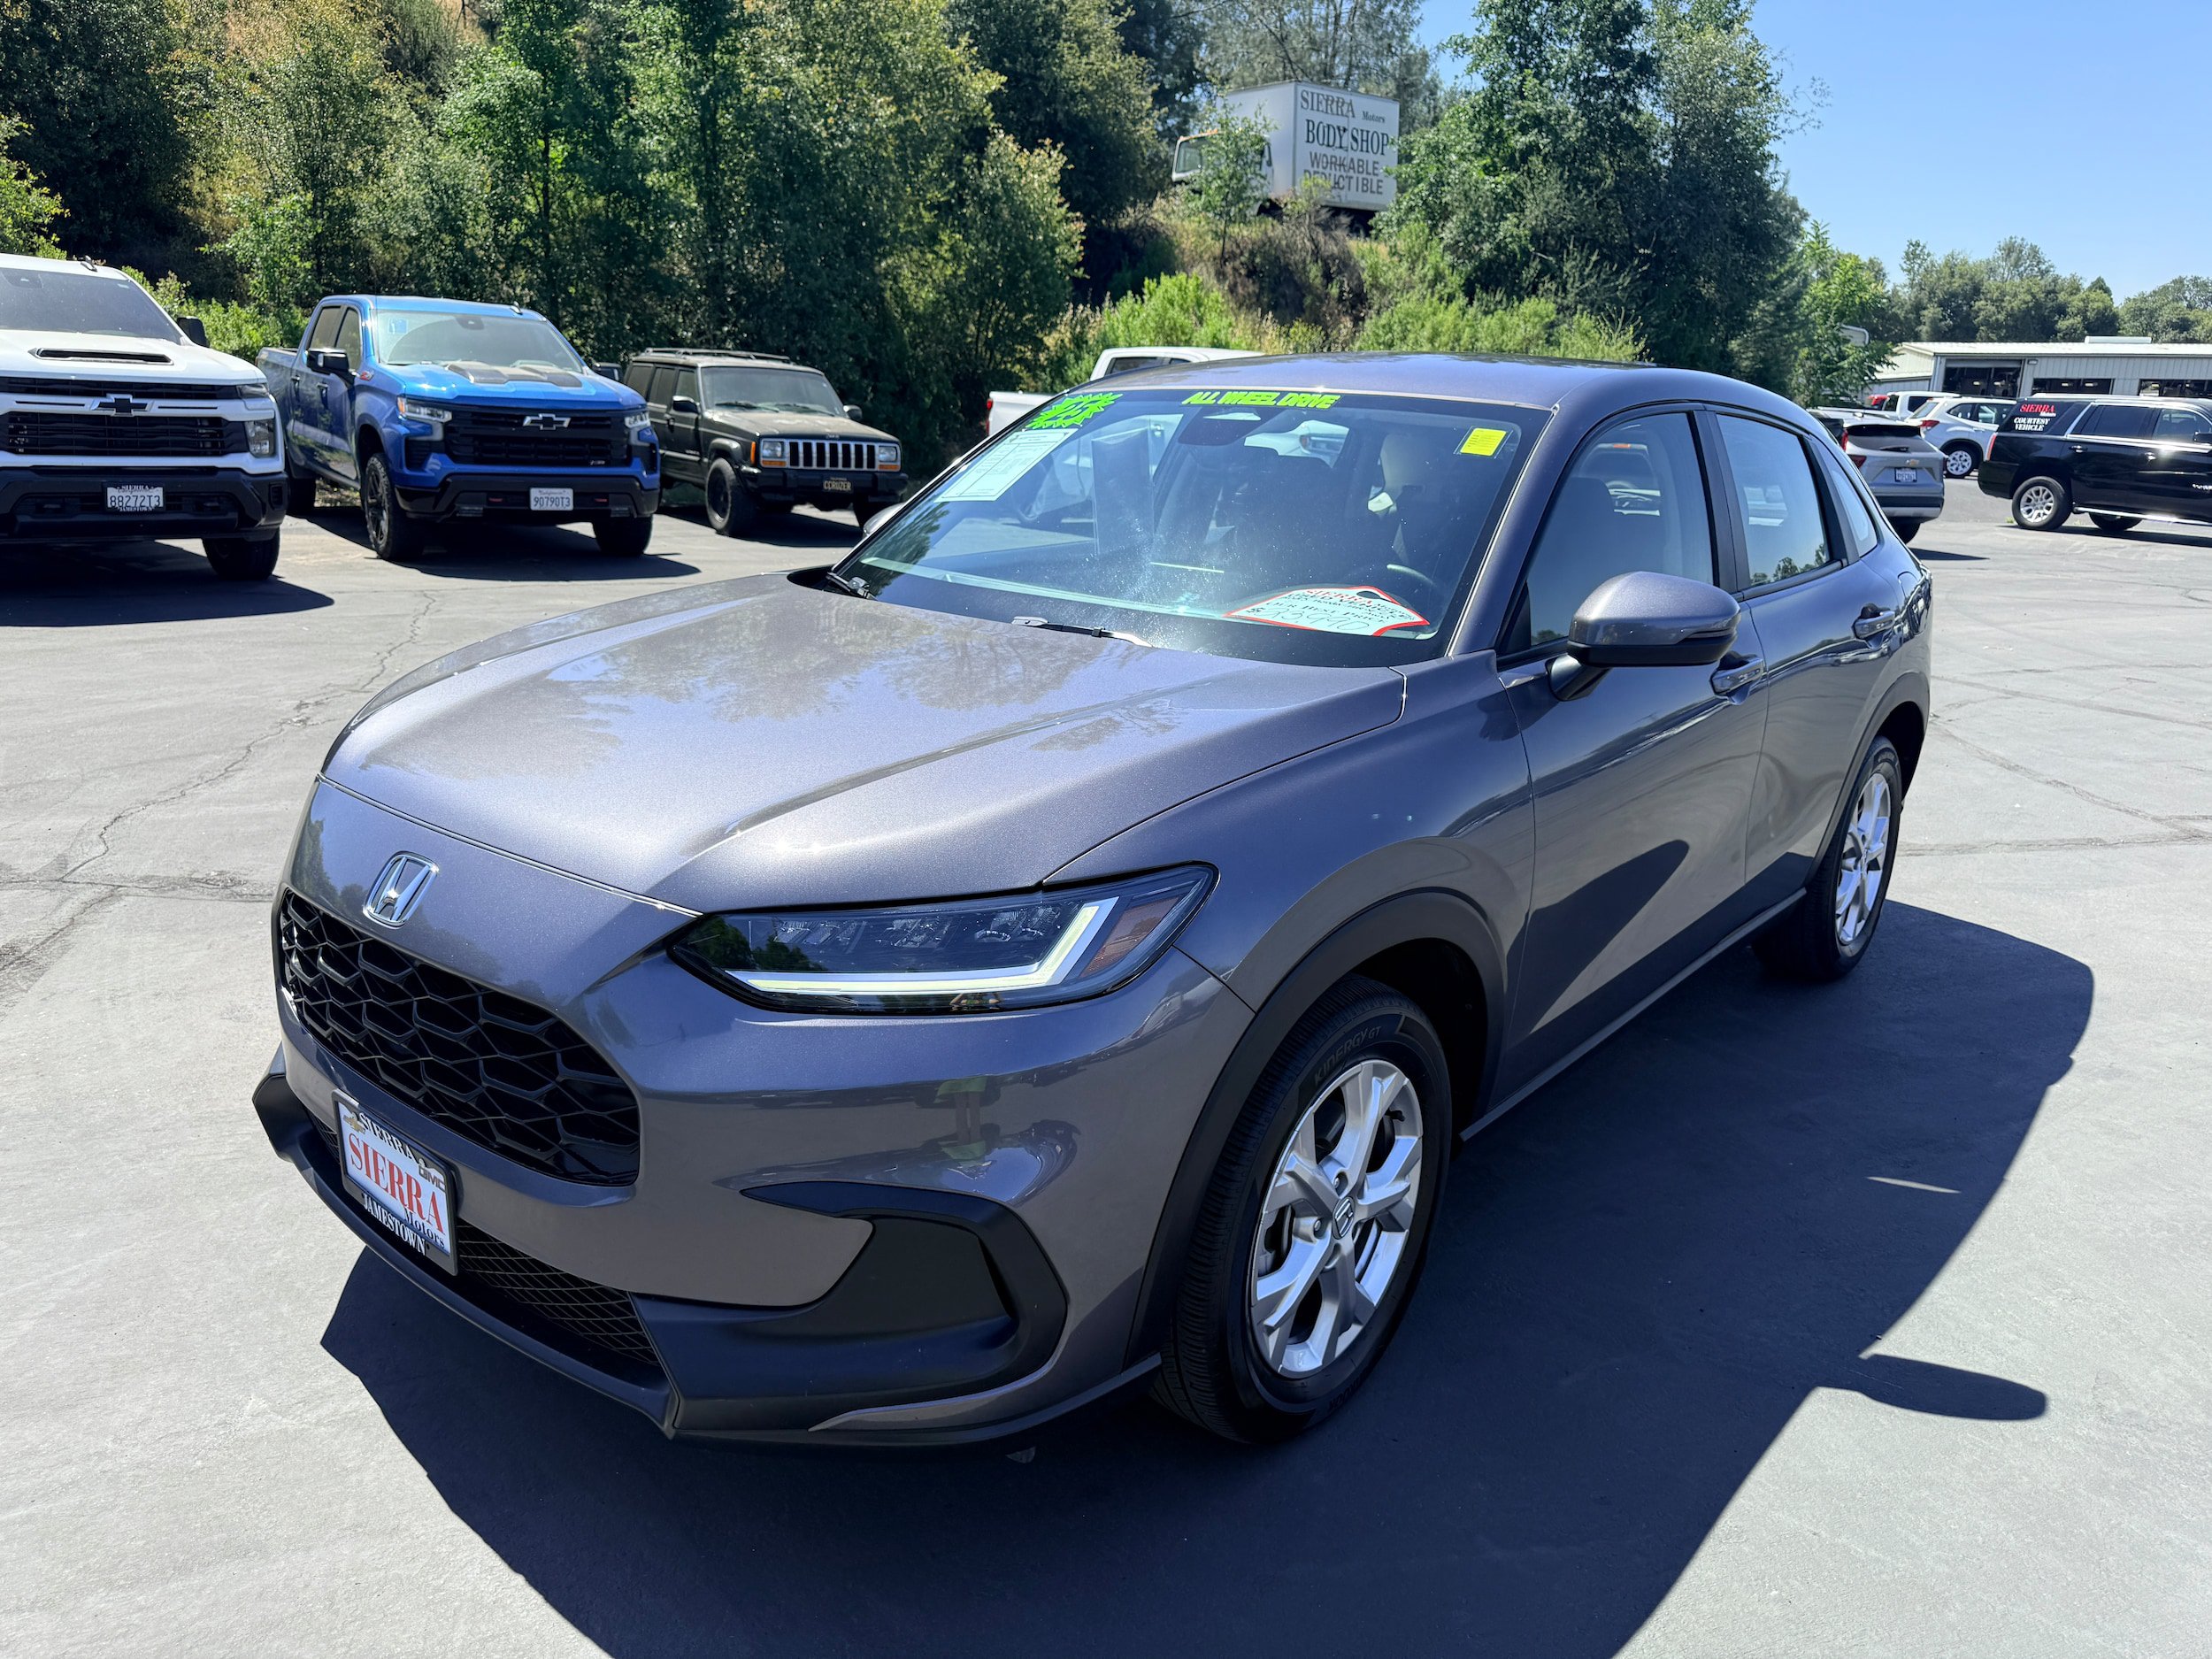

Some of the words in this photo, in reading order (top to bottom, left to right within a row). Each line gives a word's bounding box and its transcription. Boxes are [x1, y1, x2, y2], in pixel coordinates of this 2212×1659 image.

[1300, 89, 1356, 118] SIERRA
[1362, 111, 1385, 123] Motors
[1305, 119, 1348, 150] BODY
[1350, 127, 1389, 156] SHOP
[1310, 150, 1379, 176] WORKABLE
[1181, 391, 1221, 404] ALL
[1217, 391, 1280, 406] WHEEL
[1277, 392, 1340, 409] DRIVE
[2020, 403, 2055, 412] SIERRA
[110, 495, 160, 508] 88272T3
[534, 496, 571, 507] 90790T3
[1314, 1028, 1367, 1086] KINERGY
[1367, 1025, 1382, 1039] GT
[358, 1112, 419, 1164] SIERRA
[349, 1133, 445, 1235] SIERRA
[419, 1164, 445, 1191] GMC
[361, 1192, 426, 1256] JAMESTOWN
[403, 1207, 445, 1248] Motors
